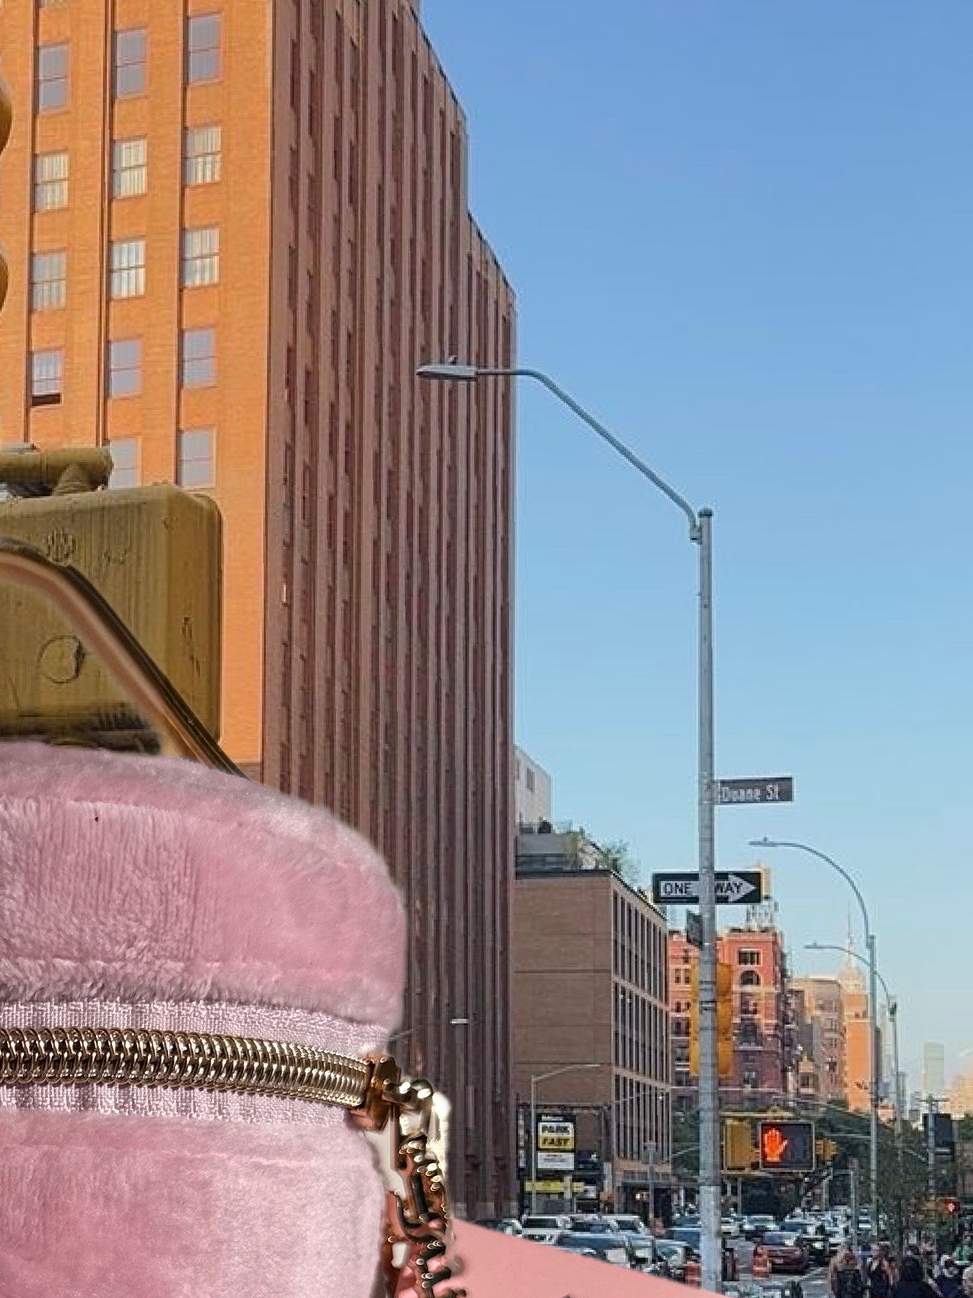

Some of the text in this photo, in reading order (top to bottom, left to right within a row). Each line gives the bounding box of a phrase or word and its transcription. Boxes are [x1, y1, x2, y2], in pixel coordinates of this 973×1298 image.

[721, 784, 780, 802] Duane St
[663, 881, 744, 897] ONE WAY
[541, 1124, 570, 1134] PARK
